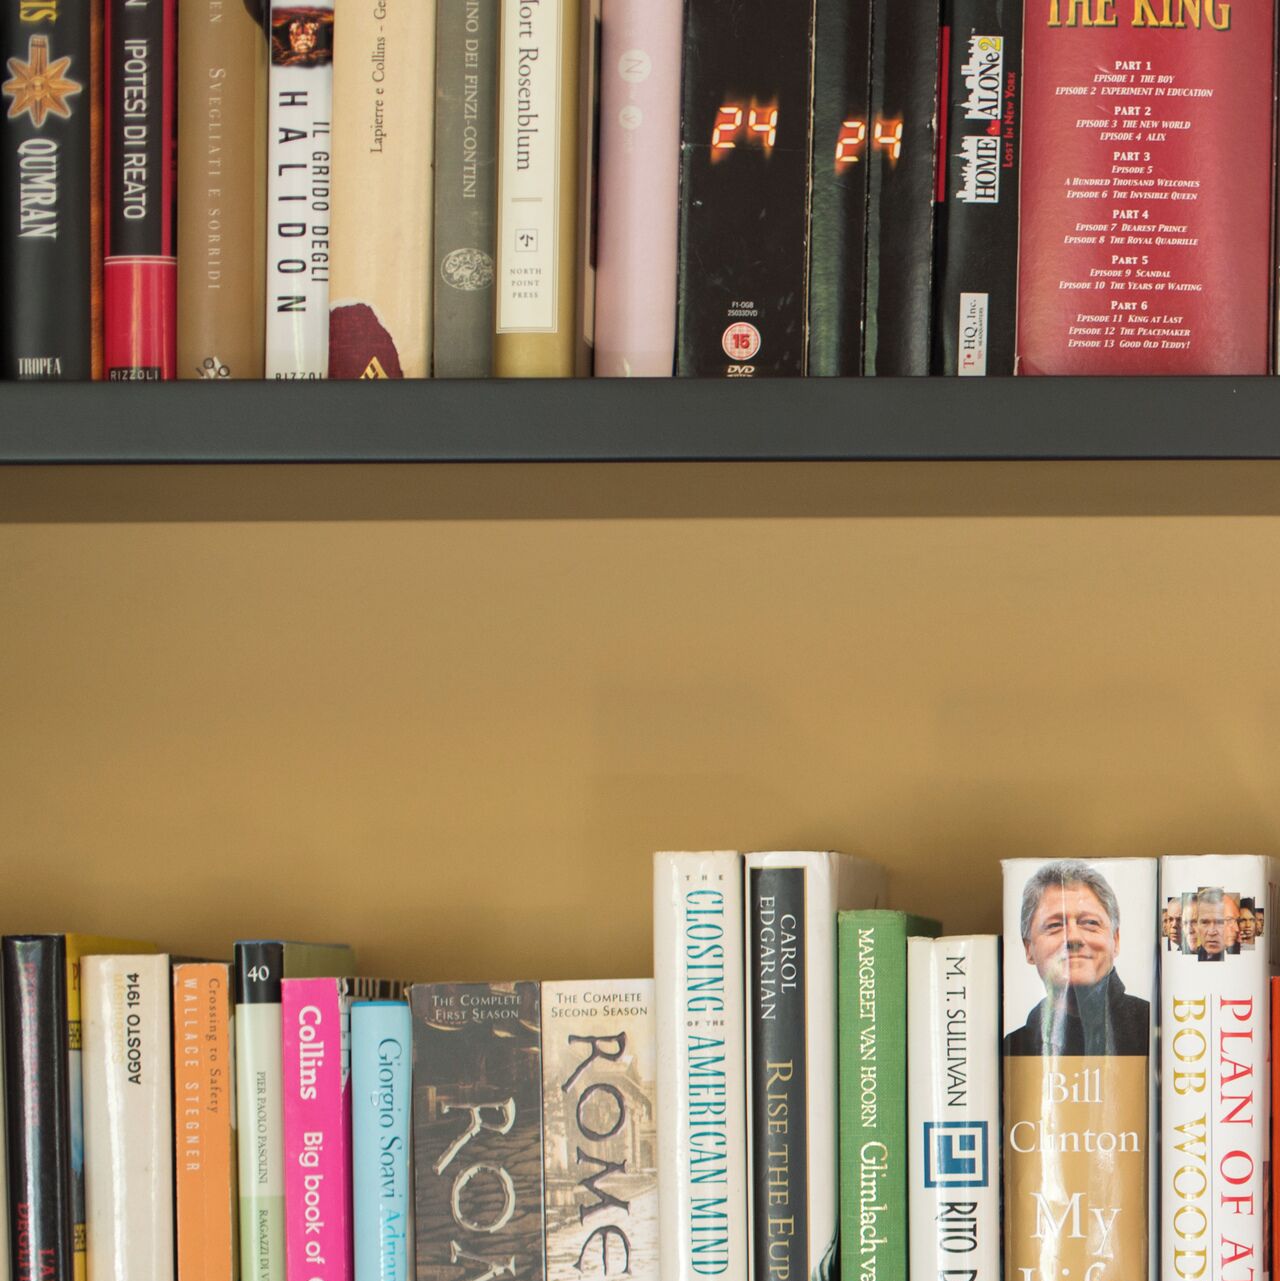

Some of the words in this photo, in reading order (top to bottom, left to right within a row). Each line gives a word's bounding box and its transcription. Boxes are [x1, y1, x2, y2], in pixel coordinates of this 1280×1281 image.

[124, 39, 147, 123] IPOTESI
[372, 37, 386, 83] Collins
[1094, 75, 1126, 83] EPISODE
[1115, 61, 1141, 70] PART
[1146, 62, 1151, 70] 1
[376, 86, 384, 94] e
[517, 48, 538, 171] Rosenblum
[1056, 87, 1088, 95] EPISODE
[1101, 88, 1152, 96] EXPERIMENT
[1155, 88, 1164, 96] IN
[1167, 88, 1213, 97] EDUCATION
[1114, 107, 1140, 115] PART
[1144, 107, 1151, 115] 2
[124, 126, 147, 146] DI
[313, 122, 330, 138] IL
[370, 100, 387, 153] Lapierre
[712, 106, 778, 148] 24
[1076, 120, 1110, 128] EPISODE
[1111, 120, 1117, 128] 3
[1123, 120, 1137, 128] THE
[1162, 121, 1191, 129] WORLD
[18, 139, 57, 239] QUMRAN
[124, 150, 146, 219] REATO
[277, 91, 308, 313] HALIDON
[312, 151, 329, 211] GRIDO
[311, 226, 329, 282] DEGLI
[18, 357, 61, 376] TROPEA
[732, 334, 750, 349] 15
[110, 369, 159, 381] RIZZOLI
[248, 965, 269, 982] 40
[686, 890, 724, 1012] CLOSING
[760, 896, 776, 1020] EDGARIAN
[780, 915, 796, 993] CAROL
[859, 928, 875, 1021] MARGREET
[127, 973, 140, 1007] 1914
[206, 978, 220, 1041] Crossing
[127, 1015, 141, 1085] AGOSTO
[185, 978, 199, 1067] WALLACE
[860, 1024, 875, 1061] VAN
[1172, 996, 1207, 1095] BOB
[210, 1049, 216, 1061] to
[299, 1005, 324, 1100] Collins
[1219, 996, 1254, 1127] PLAN
[207, 1069, 221, 1113] Safety
[688, 1035, 728, 1184] AMERICAN
[861, 1067, 876, 1128] HOORN
[1046, 1071, 1103, 1103] Bill
[185, 1082, 200, 1170] STEGNER
[299, 1132, 323, 1167] Big
[562, 1031, 630, 1276] ROME
[1009, 1121, 1141, 1154] Clinton
[768, 1144, 789, 1205] THE
[1219, 1156, 1255, 1213] OF
[304, 1174, 325, 1234] book
[1031, 1192, 1123, 1253] My
[305, 1240, 325, 1264] of
[691, 1197, 729, 1275] MIND
